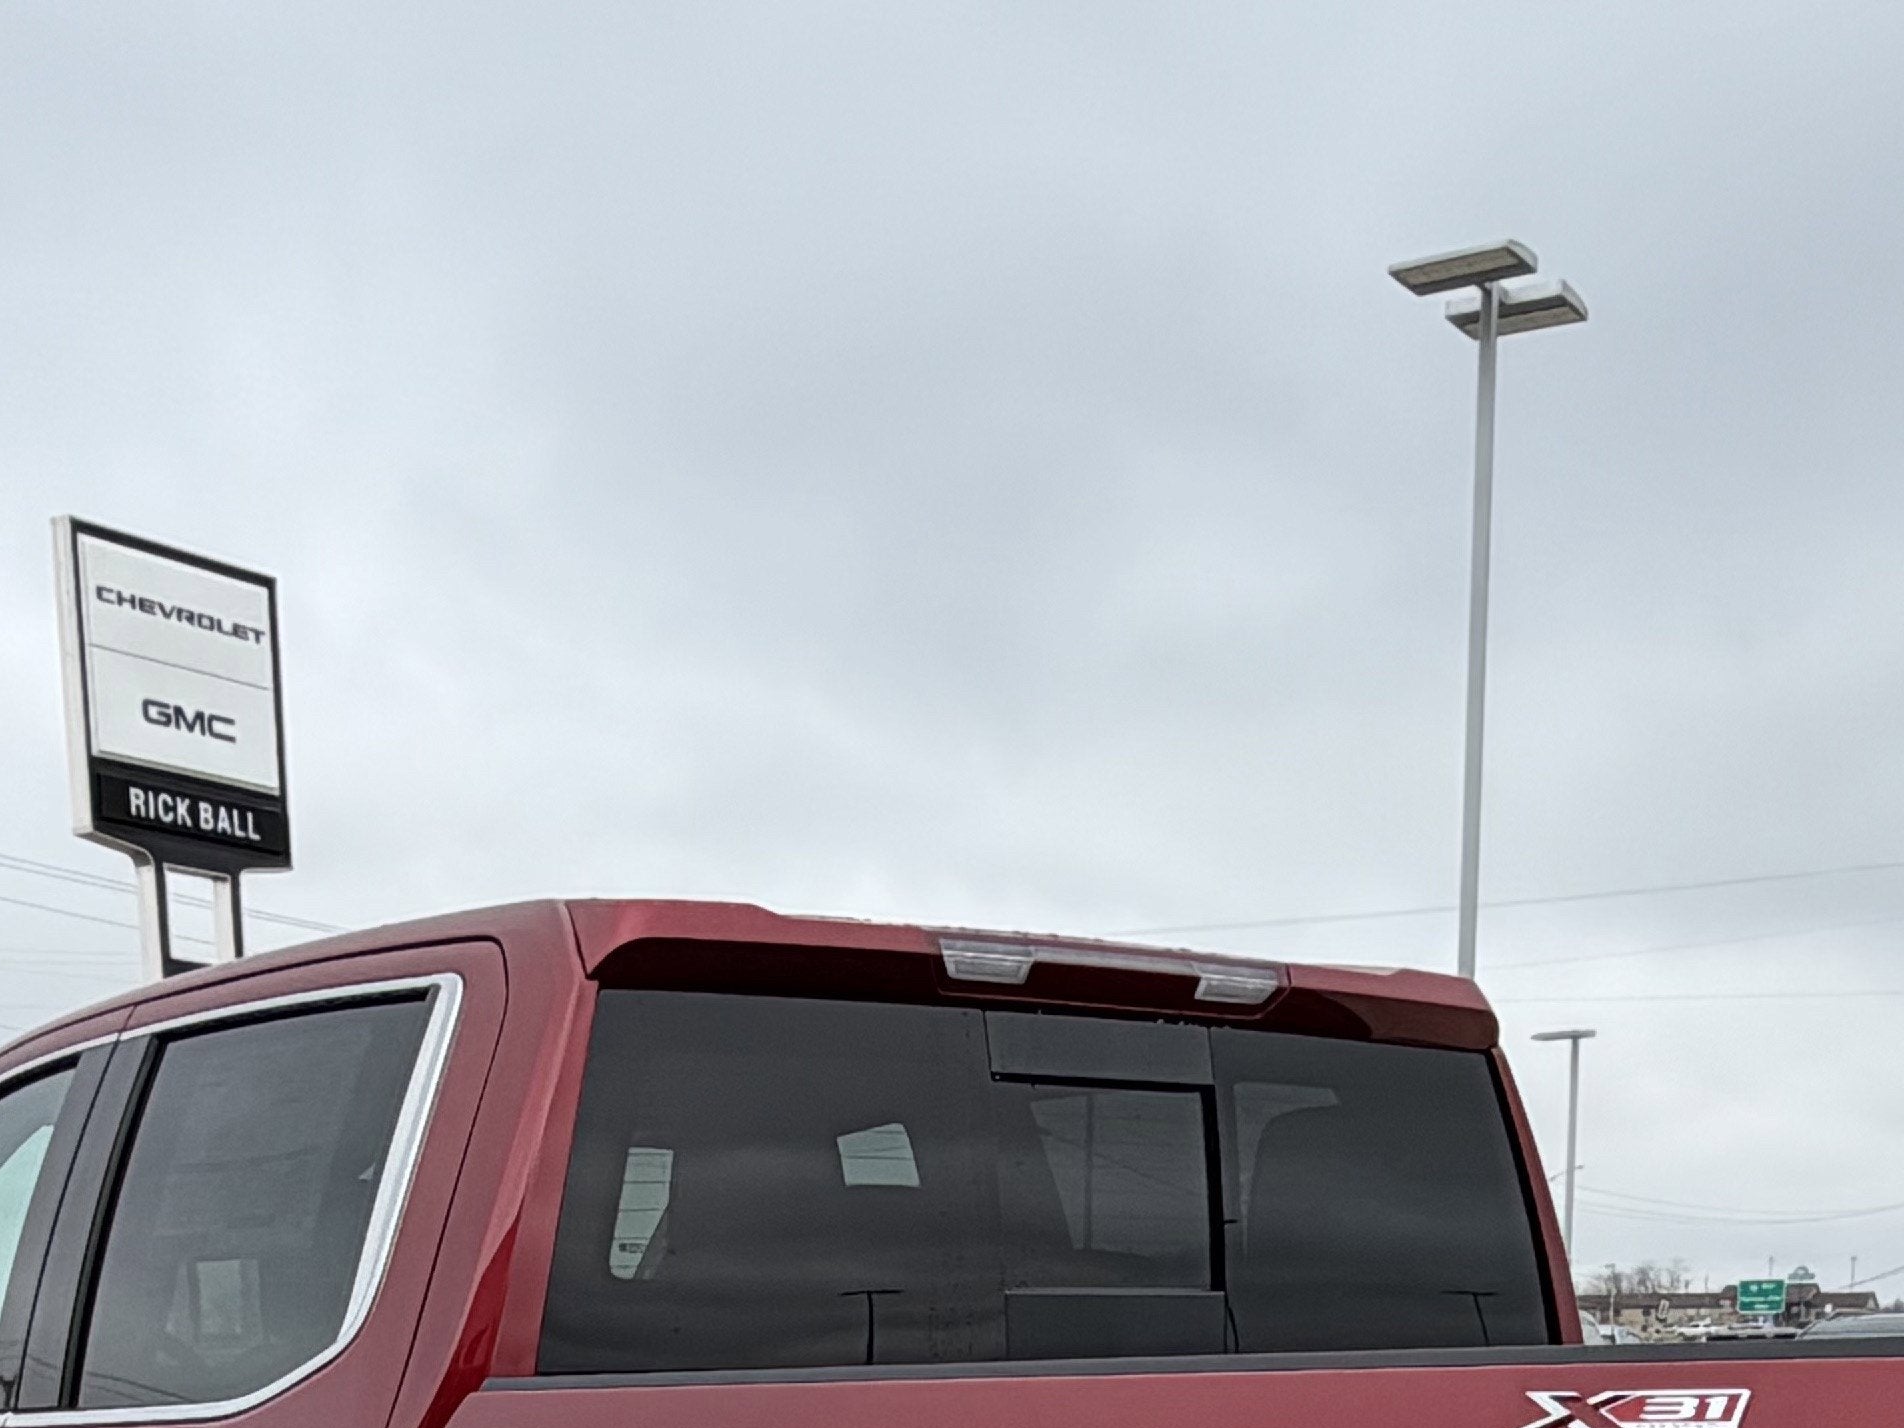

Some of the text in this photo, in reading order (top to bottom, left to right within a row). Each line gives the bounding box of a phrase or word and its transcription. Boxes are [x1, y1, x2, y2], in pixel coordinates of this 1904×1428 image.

[95, 585, 265, 644] CHEVROLET
[142, 698, 236, 744] GMC
[129, 786, 261, 841] RICK BALL
